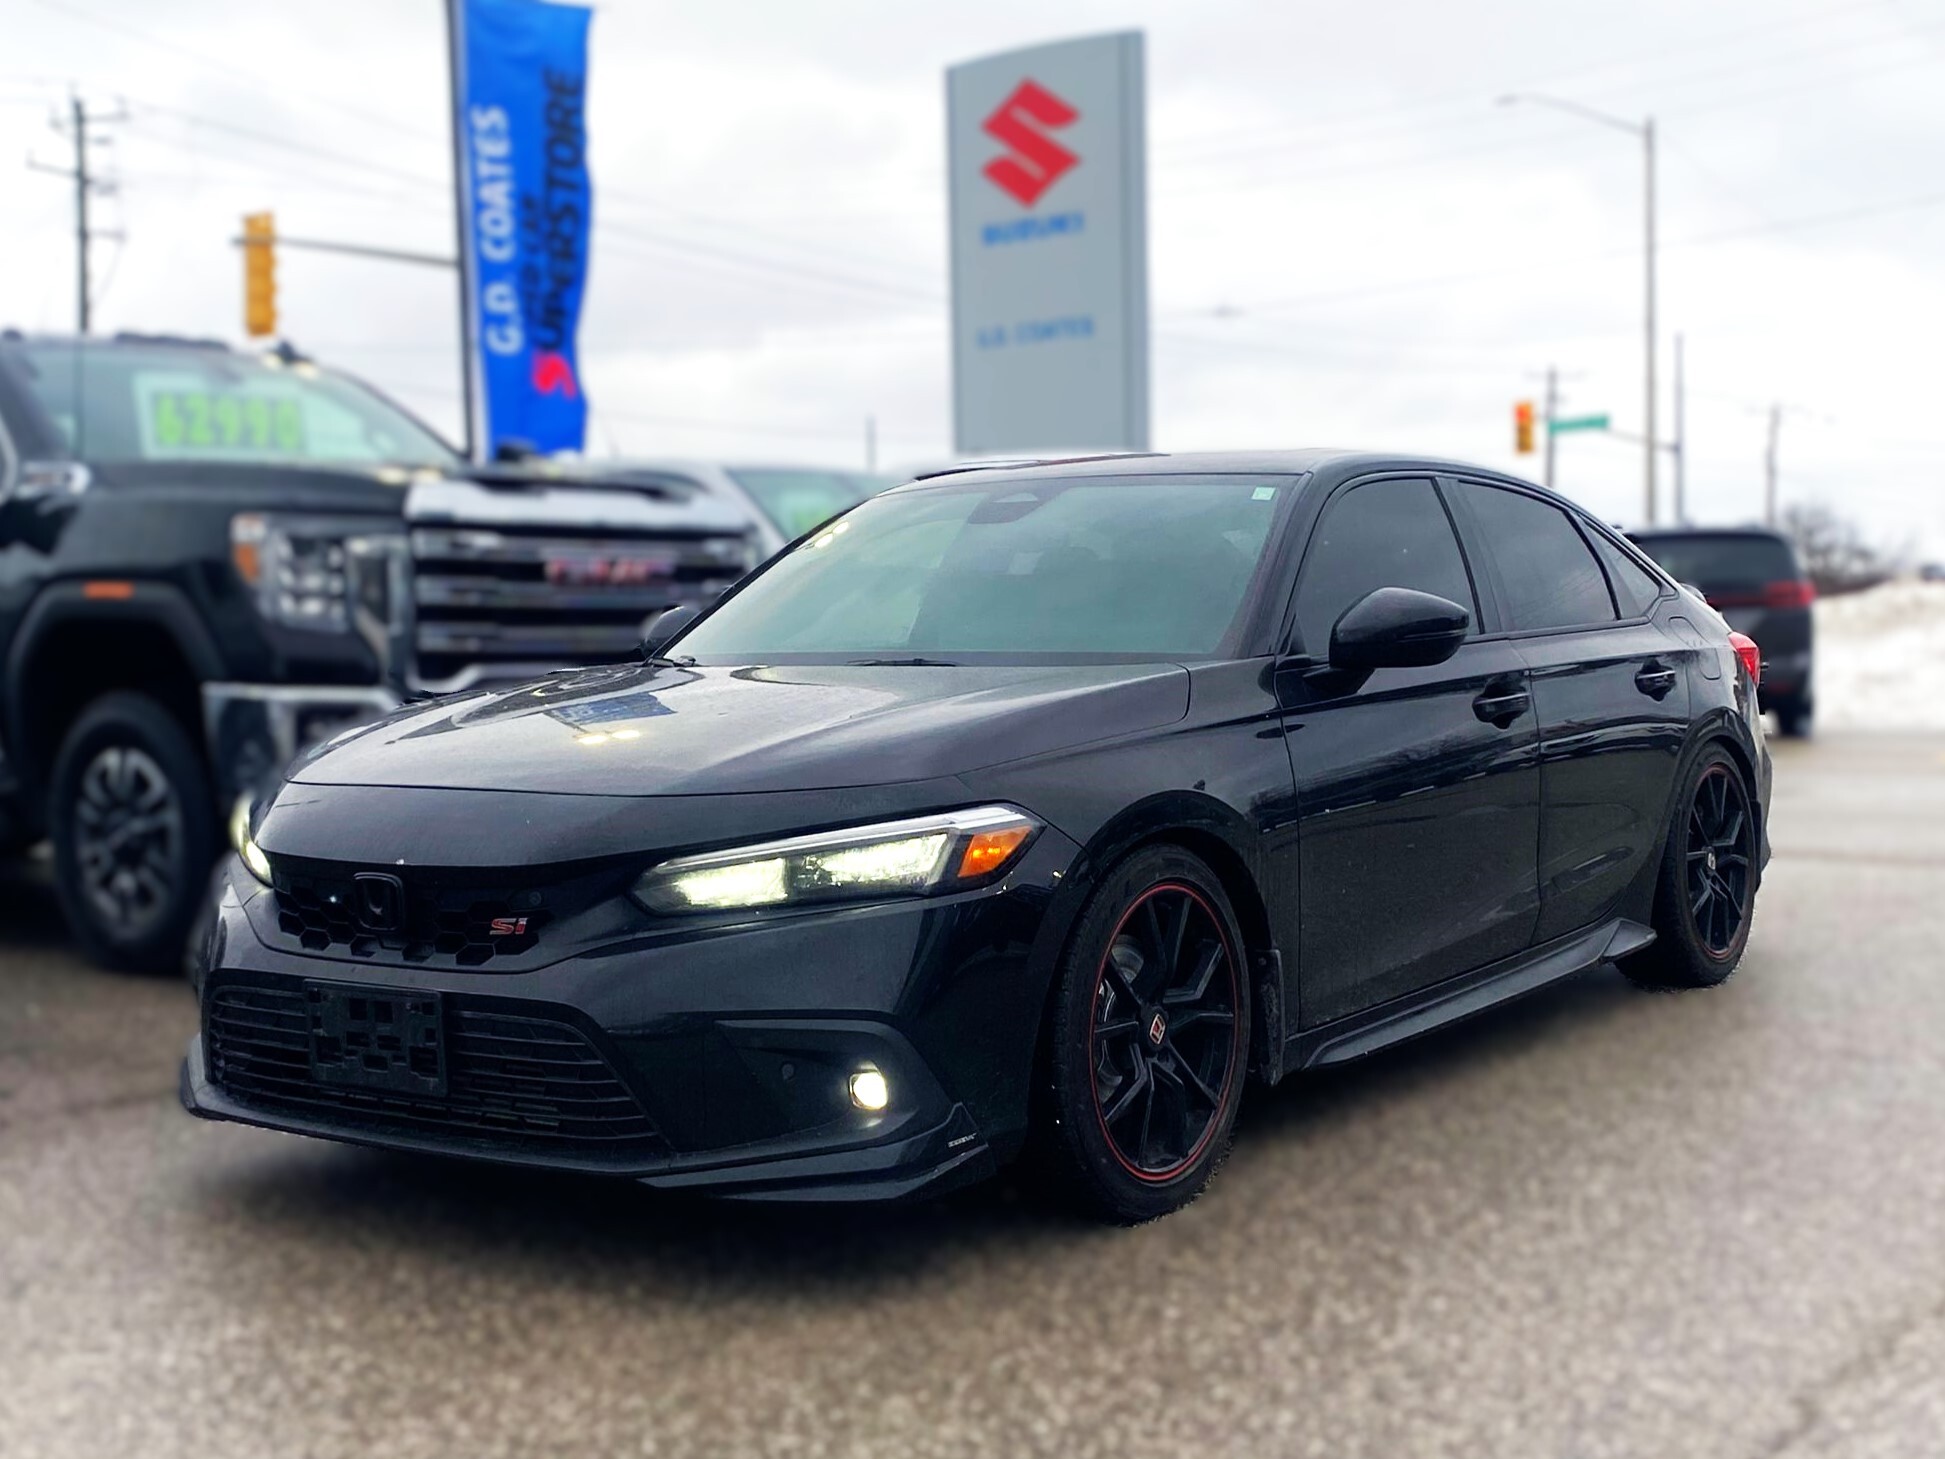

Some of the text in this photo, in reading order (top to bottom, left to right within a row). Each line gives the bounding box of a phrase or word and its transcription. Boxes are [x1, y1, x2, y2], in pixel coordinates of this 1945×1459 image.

[473, 106, 515, 262] COATES
[533, 66, 582, 399] SUPERSTORE
[489, 917, 528, 936] Si
